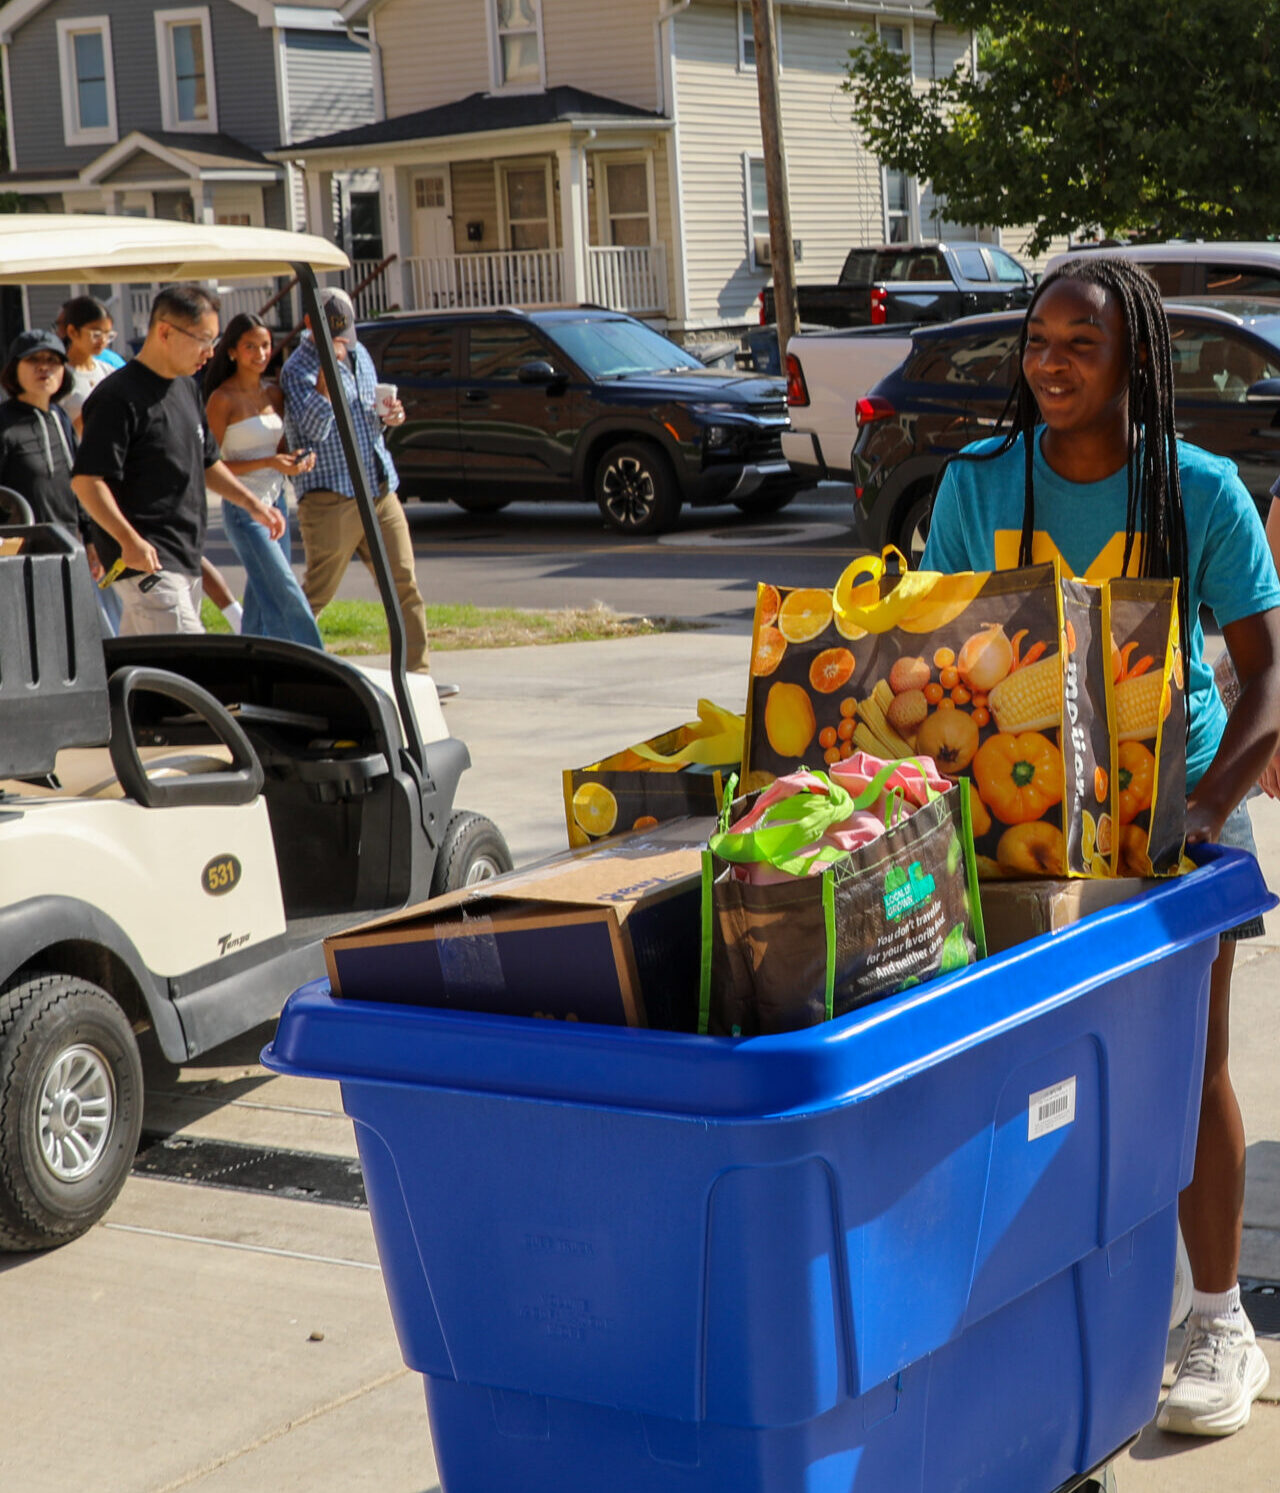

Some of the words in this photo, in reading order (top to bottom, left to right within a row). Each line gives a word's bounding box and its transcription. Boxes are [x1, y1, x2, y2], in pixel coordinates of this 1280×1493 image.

[208, 860, 235, 889] 531
[884, 883, 911, 907] LOCALLY
[887, 896, 914, 918] GROWN
[218, 932, 251, 956] Tempo
[866, 952, 880, 966] for
[882, 942, 905, 962] your
[905, 924, 936, 951] favorite
[877, 932, 894, 948] You
[894, 919, 915, 938] don't
[875, 961, 895, 980] And
[894, 947, 928, 969] neither
